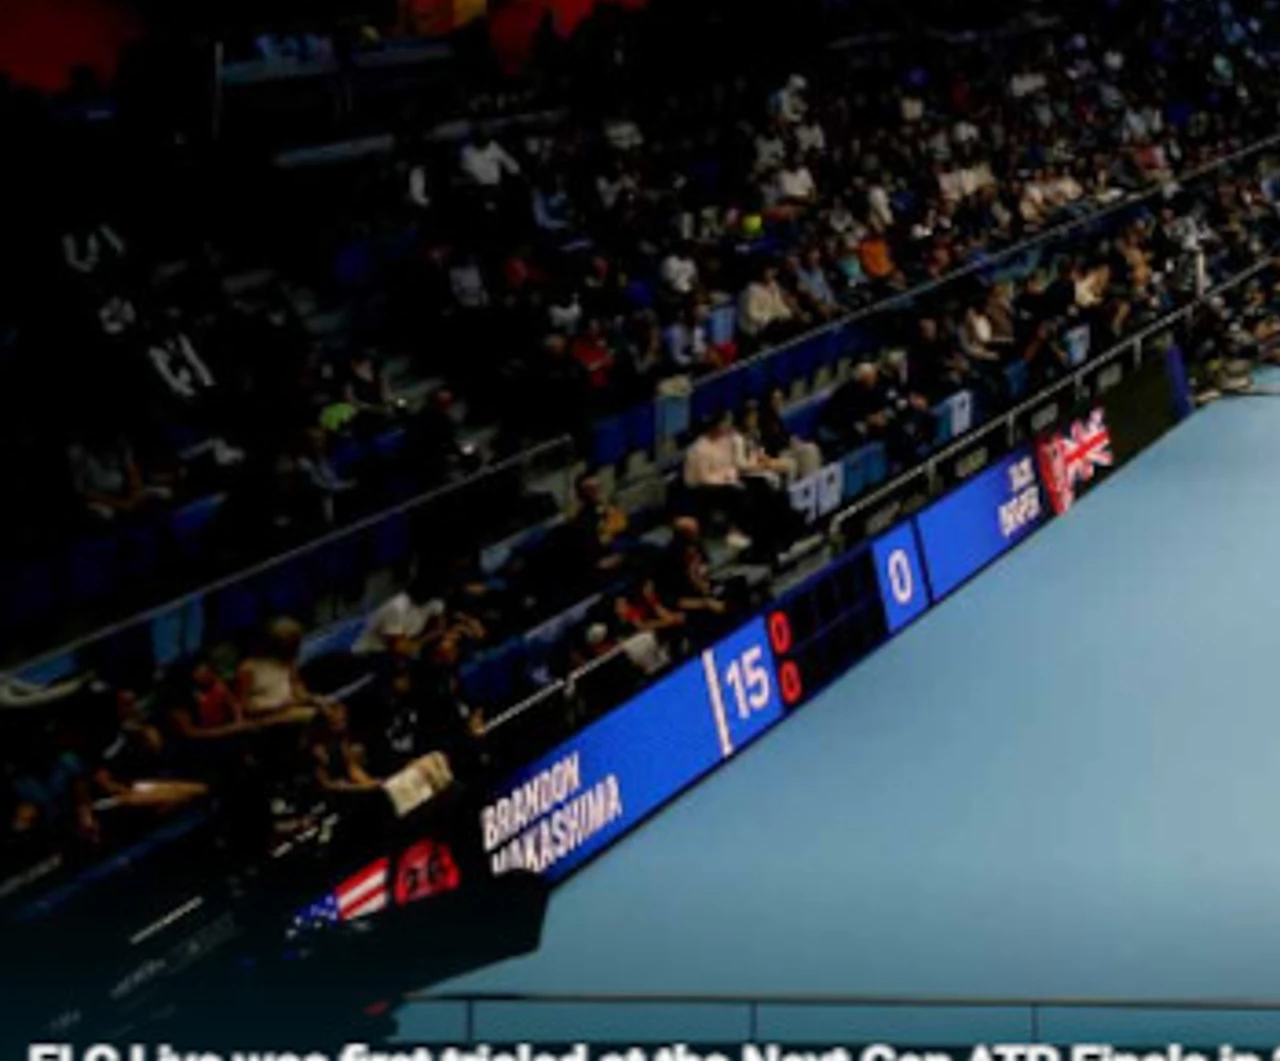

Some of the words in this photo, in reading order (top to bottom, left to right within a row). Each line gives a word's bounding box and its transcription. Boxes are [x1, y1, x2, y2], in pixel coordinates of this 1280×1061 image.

[887, 548, 914, 605] 0
[725, 644, 772, 720] 15
[480, 749, 581, 853] BRANDON
